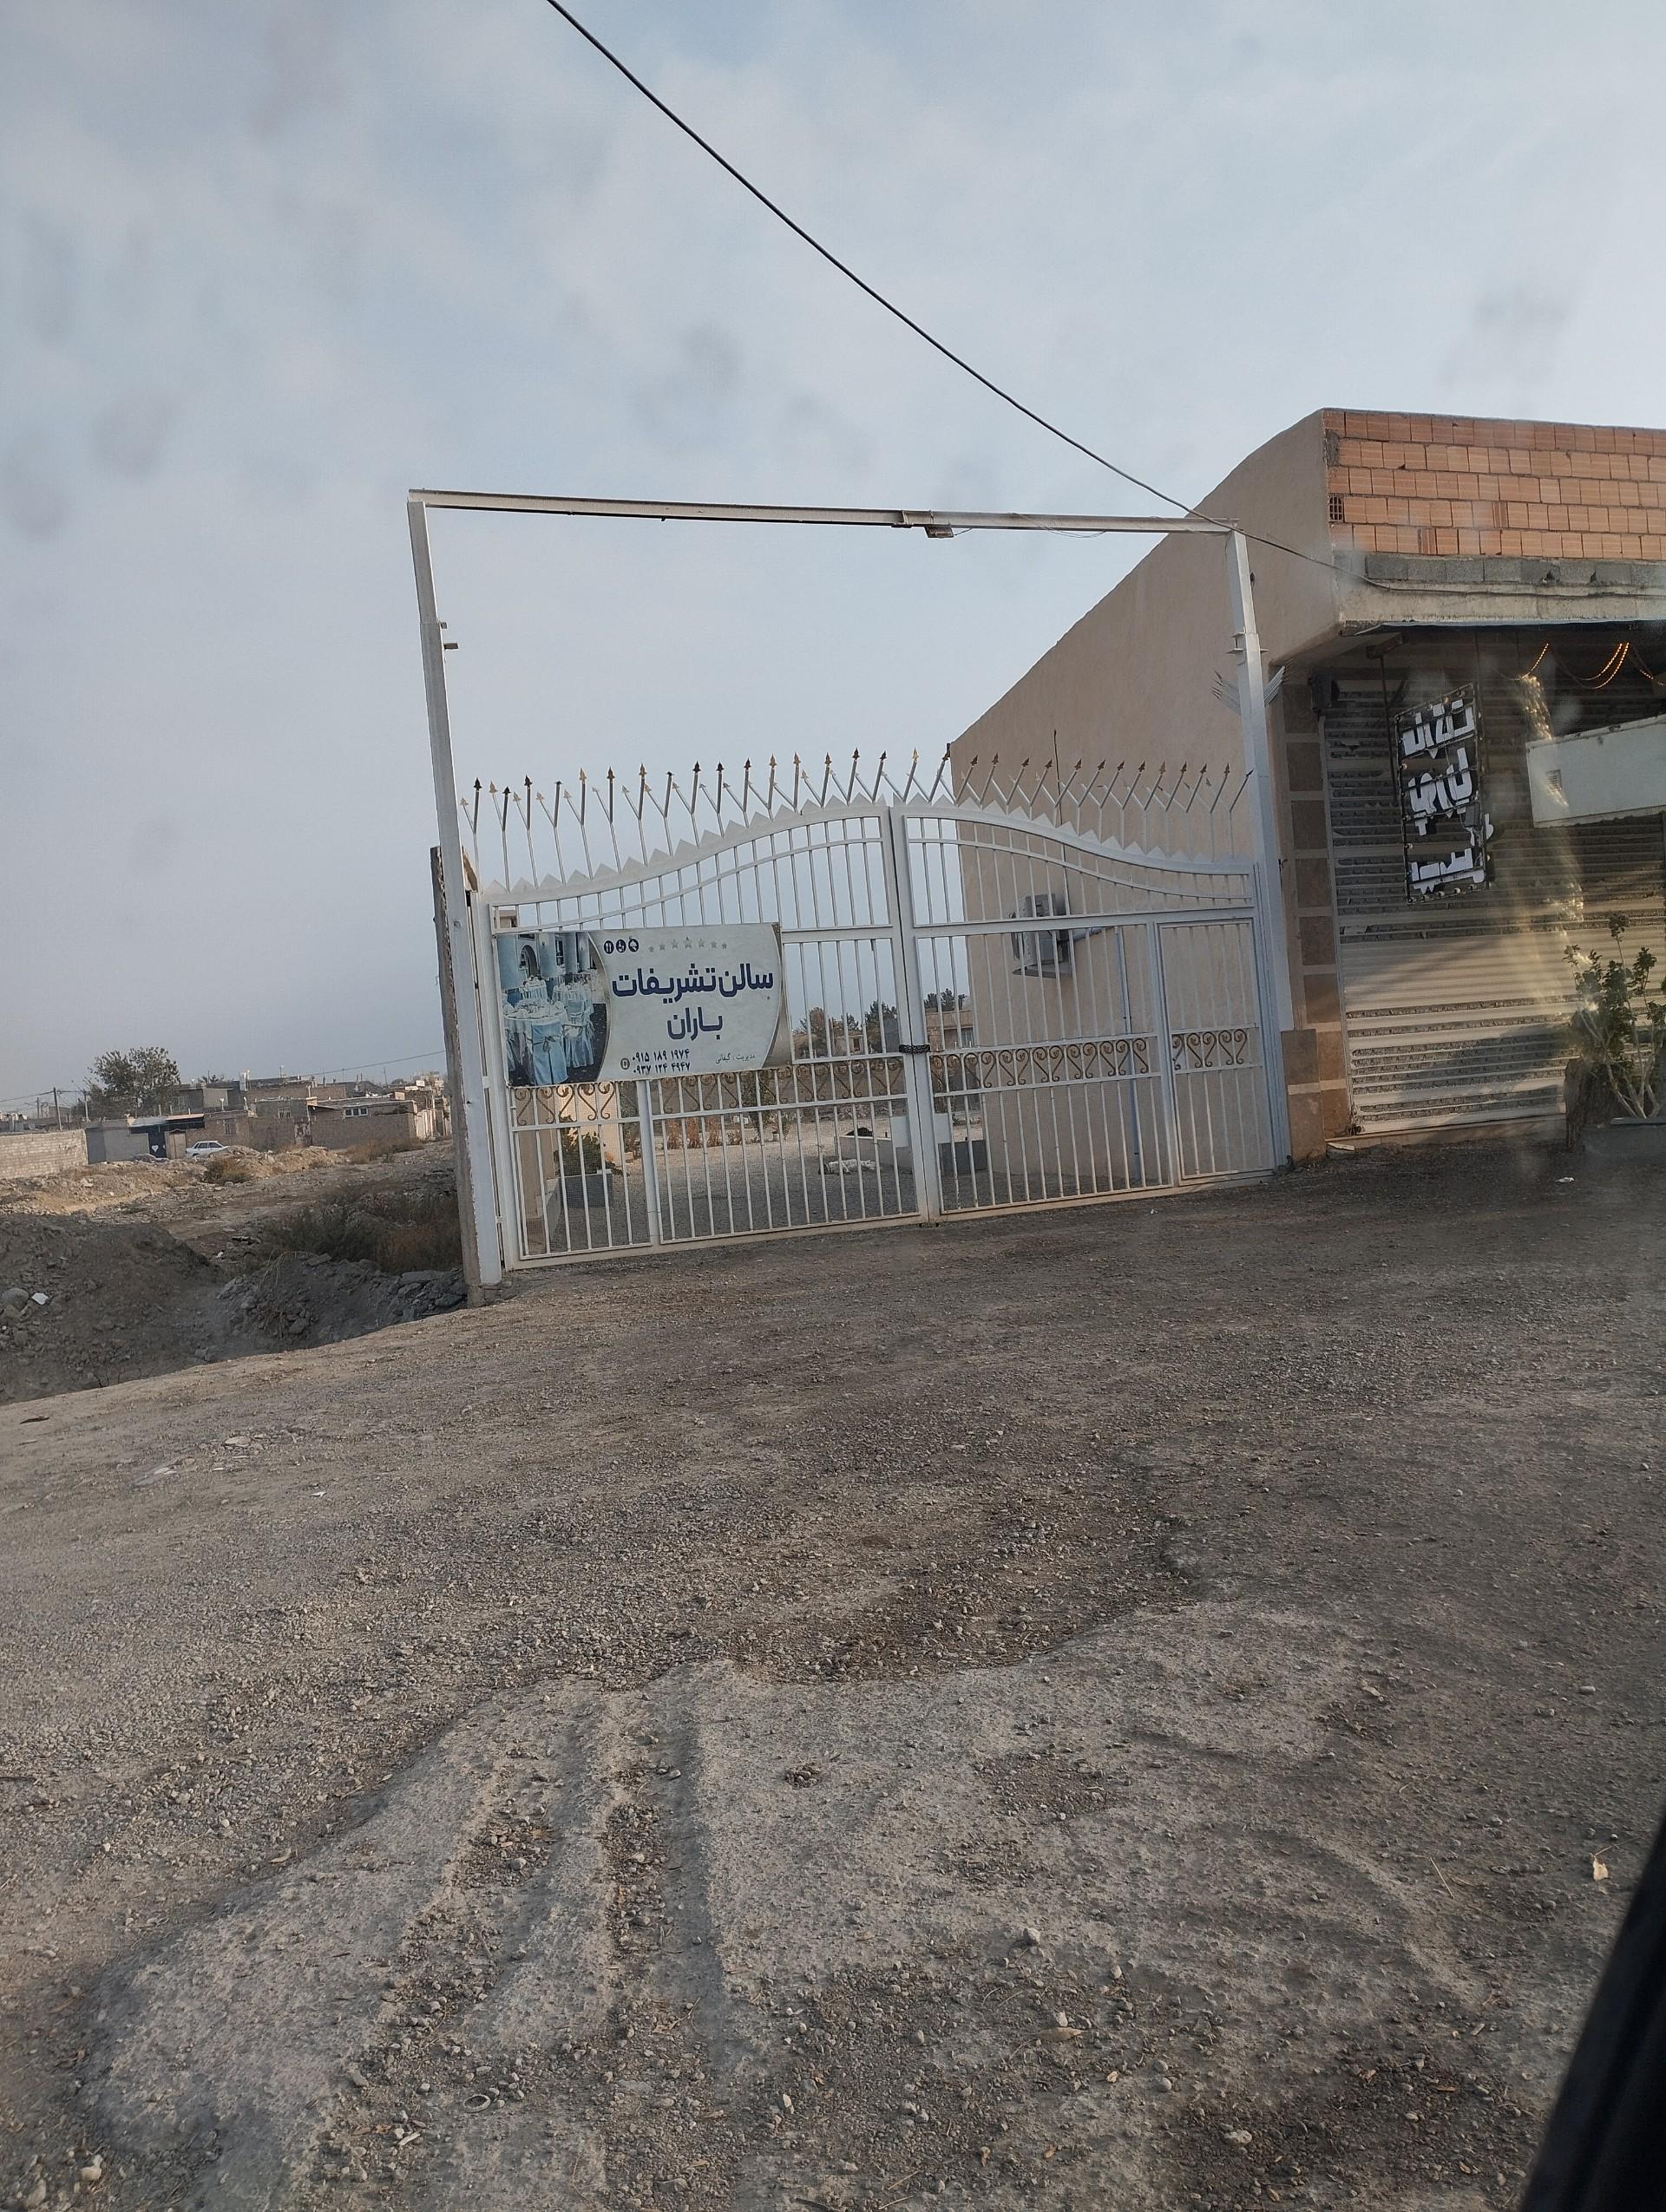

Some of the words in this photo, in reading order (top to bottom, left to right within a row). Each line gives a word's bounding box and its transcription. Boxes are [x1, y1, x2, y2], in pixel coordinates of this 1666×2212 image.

[612, 963, 717, 1005] تشریفات
[718, 963, 774, 998] سالن
[666, 1006, 724, 1041] باران
